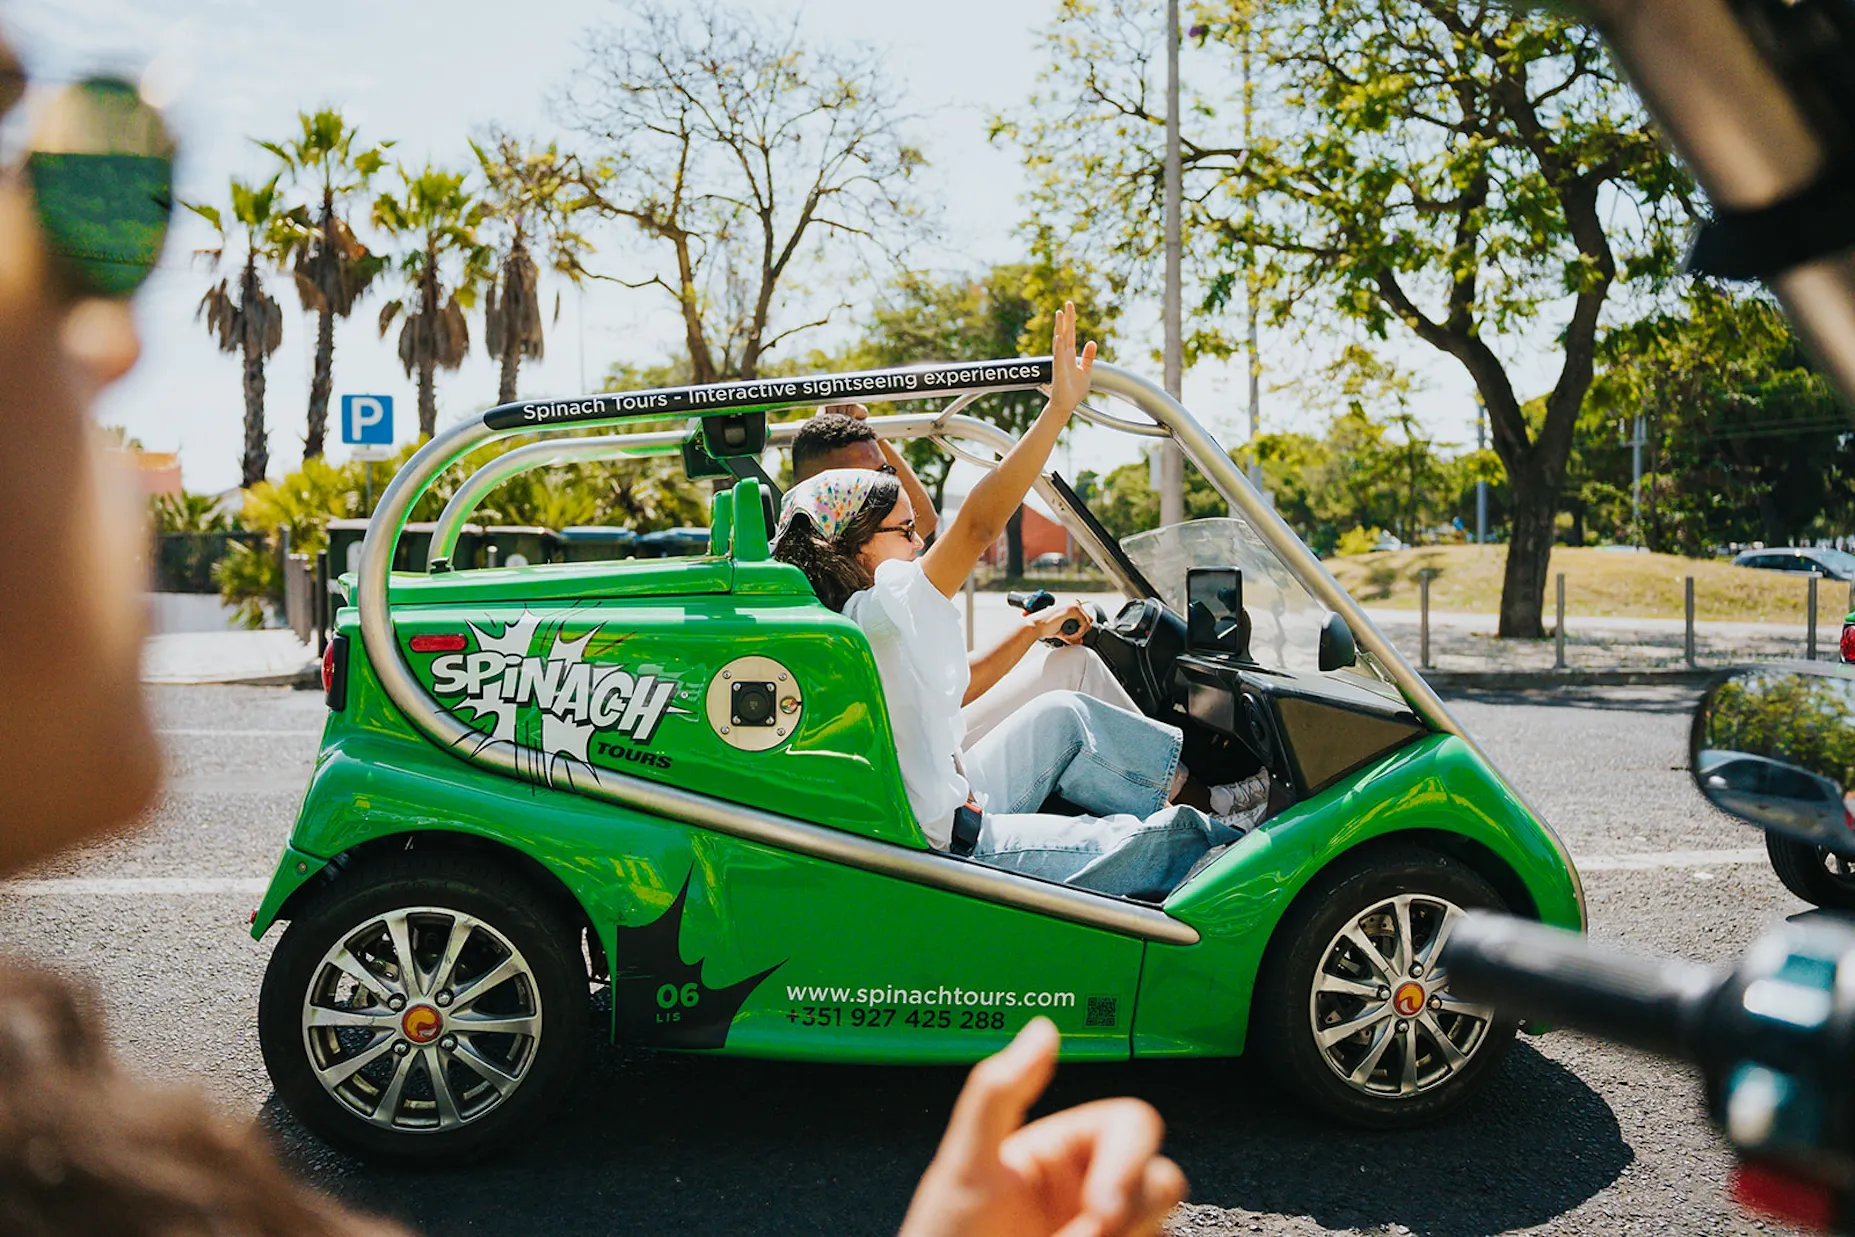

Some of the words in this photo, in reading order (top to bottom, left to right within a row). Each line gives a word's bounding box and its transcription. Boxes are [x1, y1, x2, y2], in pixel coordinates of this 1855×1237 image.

[523, 398, 606, 421] Spinach
[612, 392, 668, 411] Tours
[688, 380, 797, 404] Interactive
[802, 373, 918, 396] sightseeing
[924, 364, 1041, 386] experiences
[352, 397, 384, 441] P
[598, 742, 672, 769] TOURS
[656, 982, 699, 1009] 06
[786, 984, 1075, 1007] www.spinachtours.com
[656, 1012, 681, 1023] LIS
[786, 1007, 841, 1027] +351
[851, 1008, 896, 1028] 927
[905, 1009, 951, 1029] 425
[959, 1011, 1005, 1030] 288
